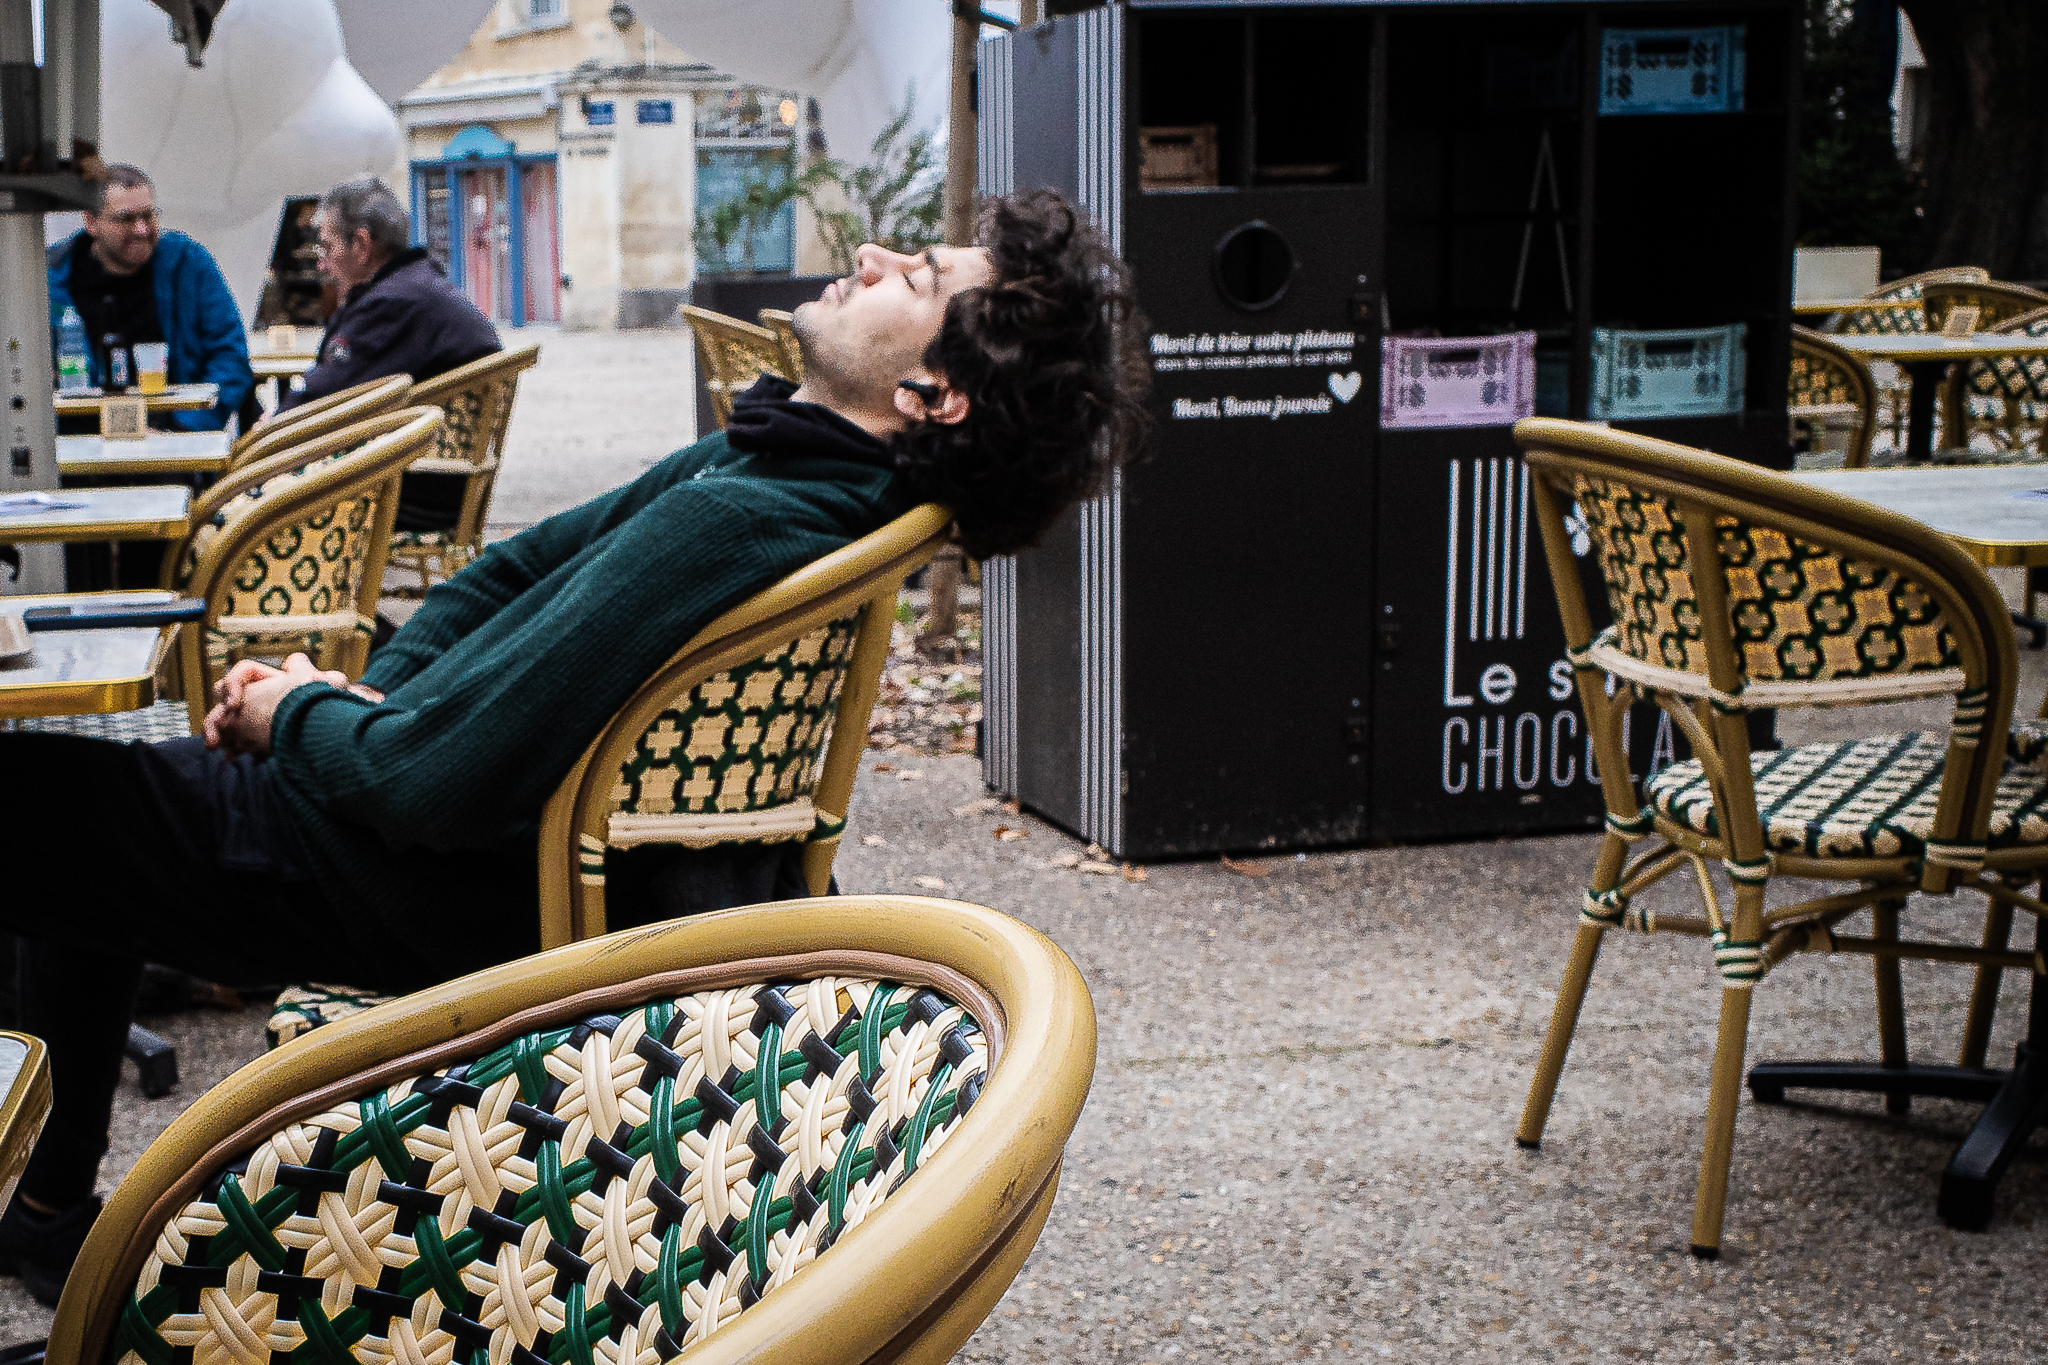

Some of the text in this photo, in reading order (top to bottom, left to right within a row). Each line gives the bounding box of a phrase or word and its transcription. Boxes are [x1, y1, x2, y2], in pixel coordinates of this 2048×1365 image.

[1150, 333, 1195, 354] Merci
[1196, 332, 1215, 352] de
[1443, 458, 1518, 707] Le
